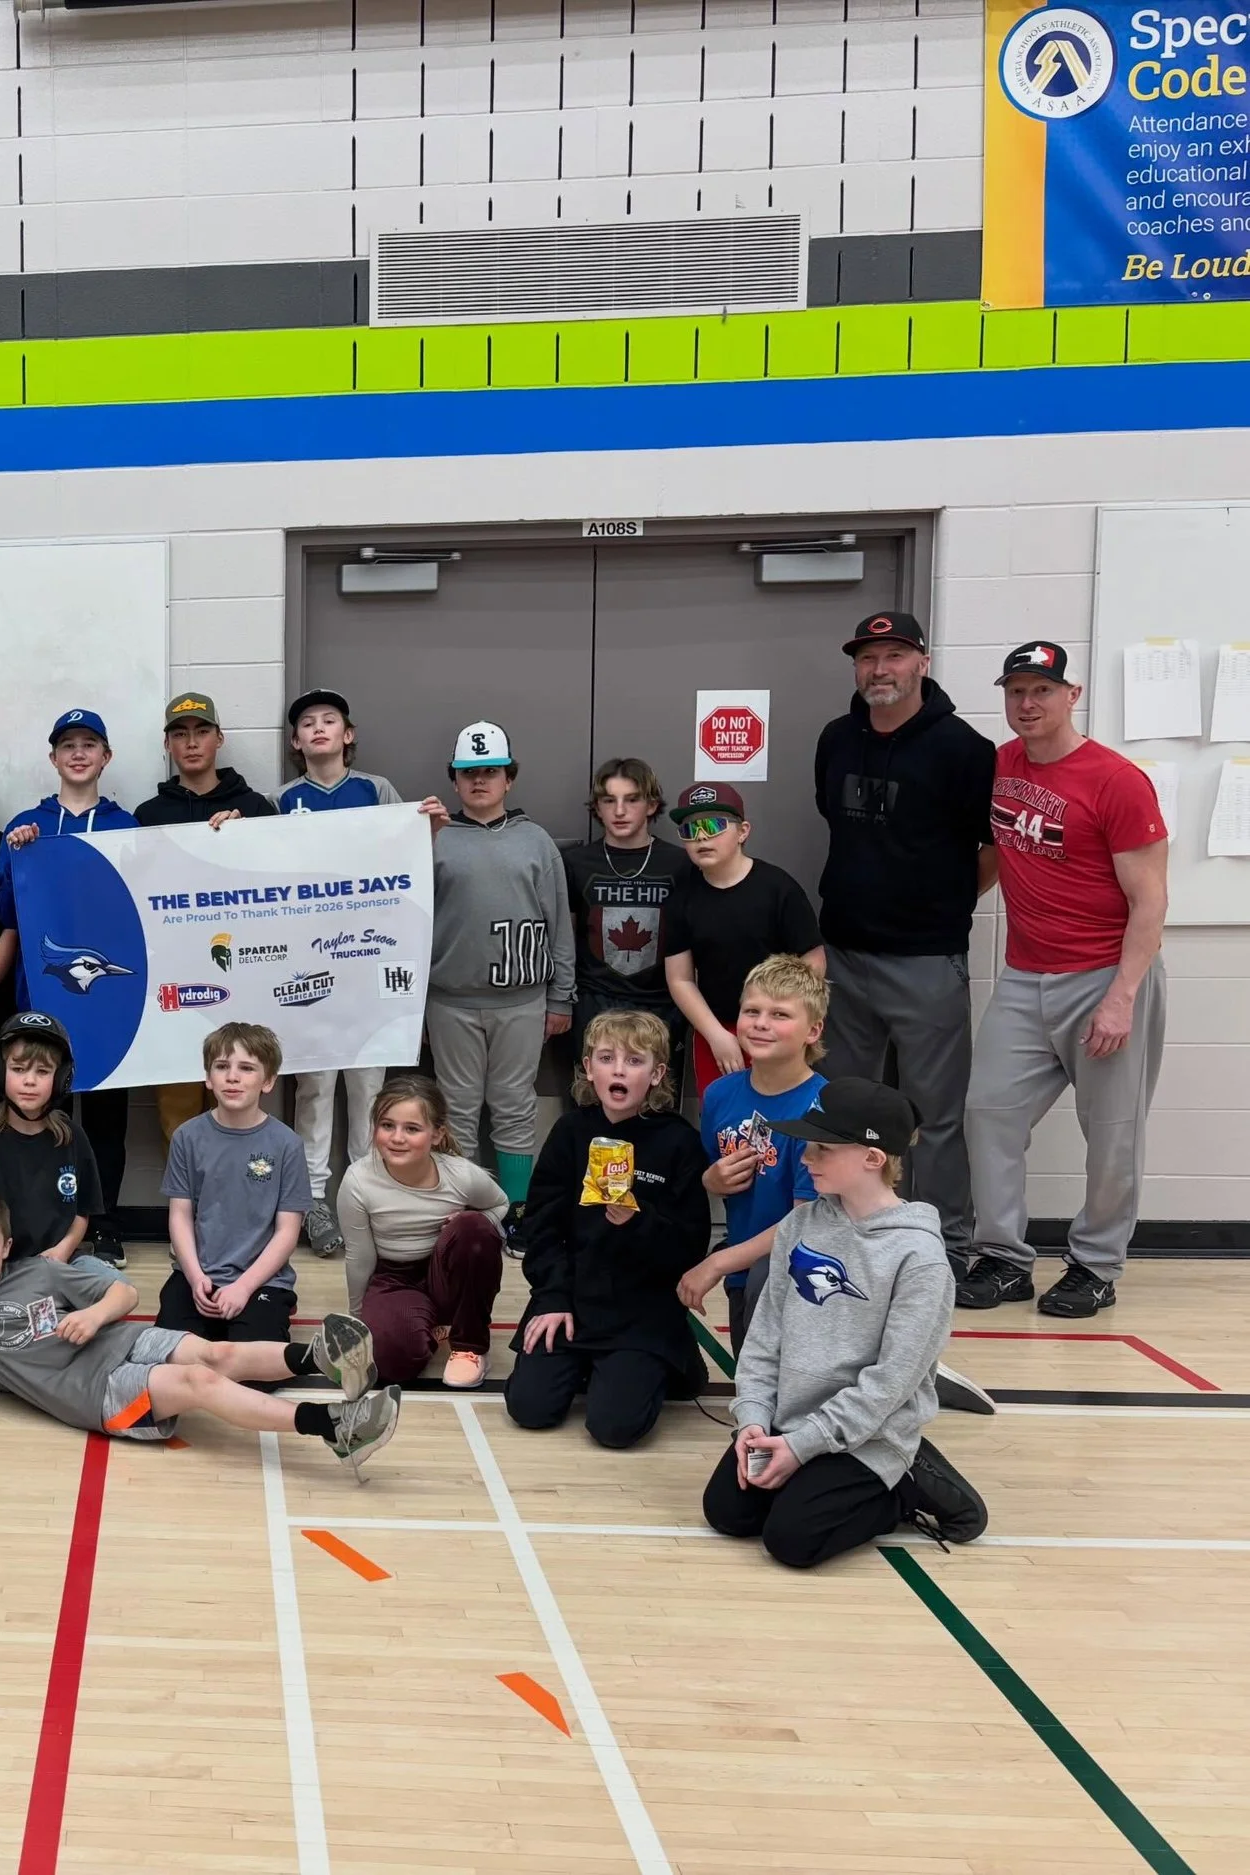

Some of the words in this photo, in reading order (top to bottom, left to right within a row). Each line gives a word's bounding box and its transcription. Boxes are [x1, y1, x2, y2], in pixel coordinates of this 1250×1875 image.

[1130, 9, 1250, 58] Spec
[1129, 54, 1247, 101] Code
[1129, 111, 1248, 133] Attendance
[1128, 140, 1181, 162] enjoy
[1187, 141, 1213, 157] an
[1126, 160, 1247, 185] educational
[1125, 189, 1166, 211] and
[1126, 214, 1215, 236] coaches
[1121, 254, 1164, 281] Be
[587, 521, 638, 536] A108S
[711, 716, 727, 730] DO
[729, 716, 754, 730] NOT
[715, 731, 748, 745] ENTER
[1013, 809, 1044, 844] 44
[148, 893, 191, 911] THE
[196, 885, 292, 908] BENTLEY
[297, 880, 354, 899] BLUE
[358, 874, 412, 894] JAYS
[593, 886, 634, 902] THE
[637, 887, 670, 903] HIP
[162, 914, 183, 925] Are
[186, 911, 221, 923] Proud
[224, 909, 238, 921] To
[241, 906, 278, 919] Thank
[281, 904, 312, 916] Their
[314, 901, 344, 913] 2026
[346, 896, 401, 912] Sponsors
[238, 944, 288, 956] SPARTAN
[311, 931, 355, 954] Taylor
[360, 928, 398, 947] Snow
[238, 955, 263, 964] DELTA
[330, 947, 381, 960] TRUCKING
[161, 985, 221, 1010] Hydrodig
[273, 981, 310, 998] CLEAN
[313, 976, 335, 990] CUT
[278, 988, 332, 1003] FABRICATION
